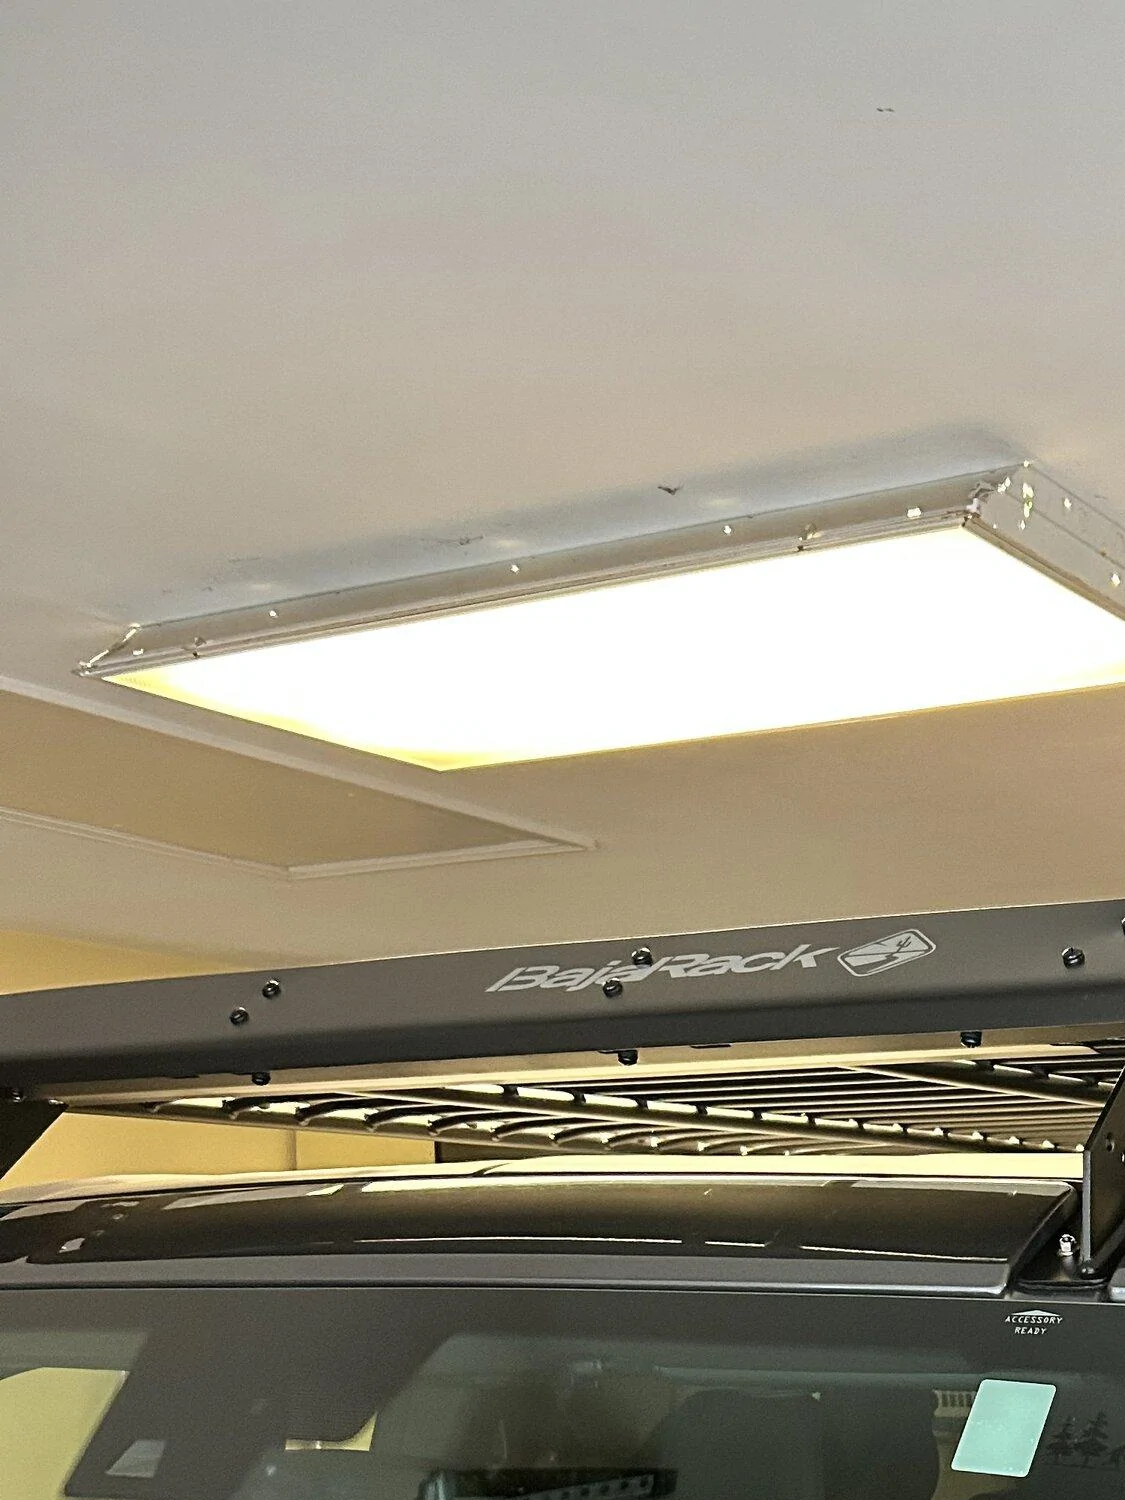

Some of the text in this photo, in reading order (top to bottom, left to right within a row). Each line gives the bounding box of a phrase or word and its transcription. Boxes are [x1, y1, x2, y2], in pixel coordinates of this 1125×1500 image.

[486, 944, 839, 992] BajaRack
[1005, 1315, 1063, 1324] ACCESSORY
[1014, 1326, 1047, 1335] READY
